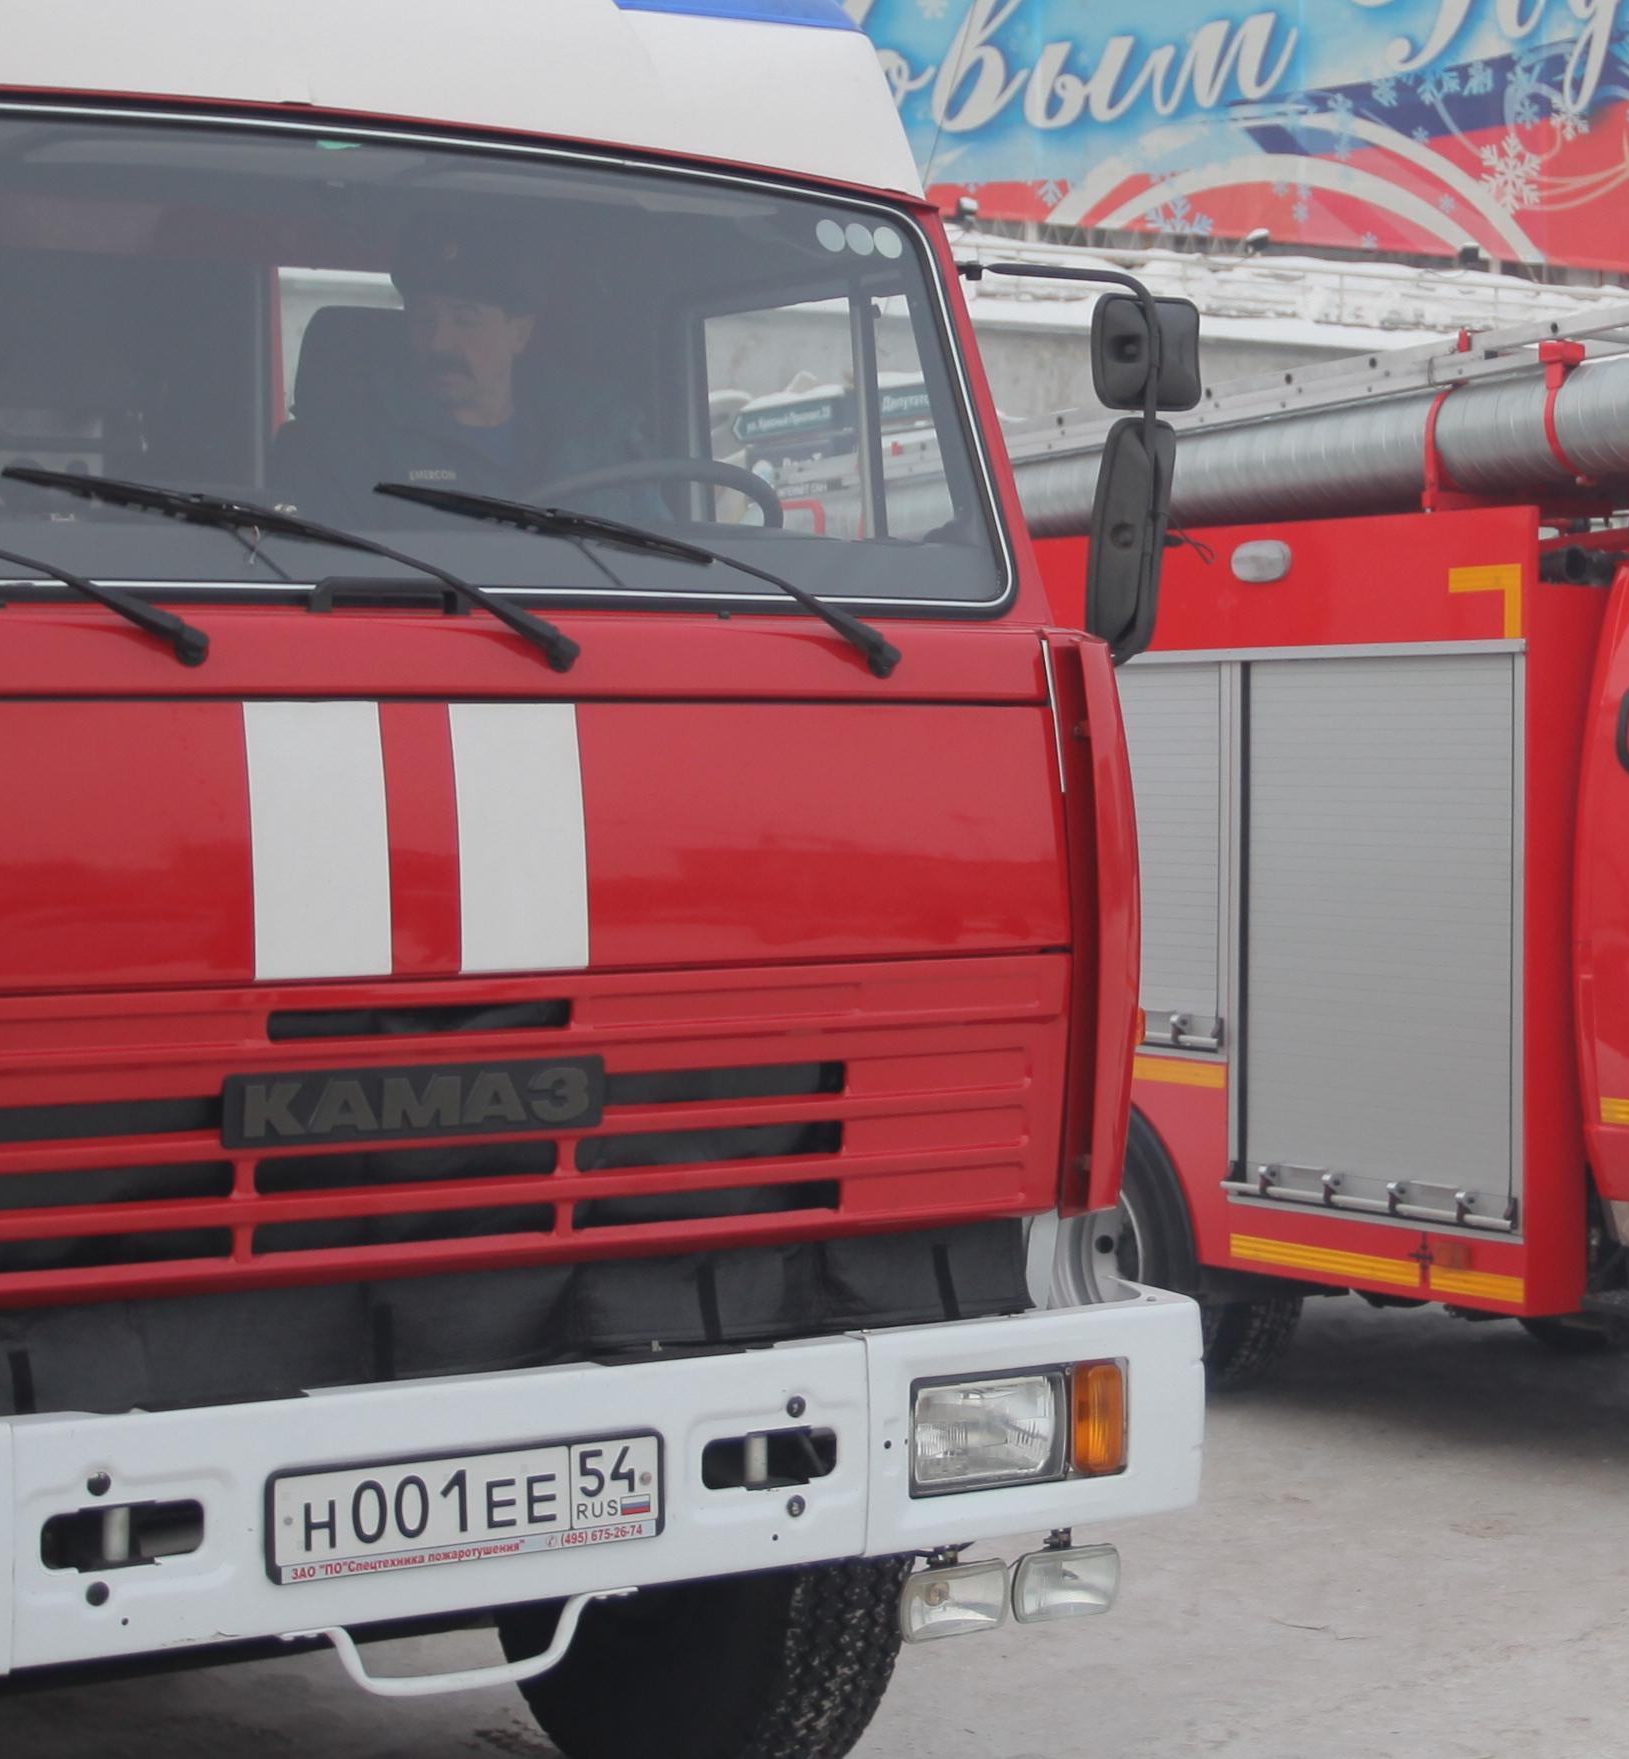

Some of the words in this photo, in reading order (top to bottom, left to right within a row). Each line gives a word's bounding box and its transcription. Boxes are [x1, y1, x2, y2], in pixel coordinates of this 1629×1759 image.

[856, 0, 1298, 132] овым
[243, 1067, 589, 1138] КАМАЗ
[303, 1468, 557, 1552] Н001ЕЕ
[578, 1445, 635, 1497] 54
[576, 1500, 618, 1520] RUS
[560, 1530, 588, 1547] (495)
[591, 1524, 643, 1542] 675-26-74
